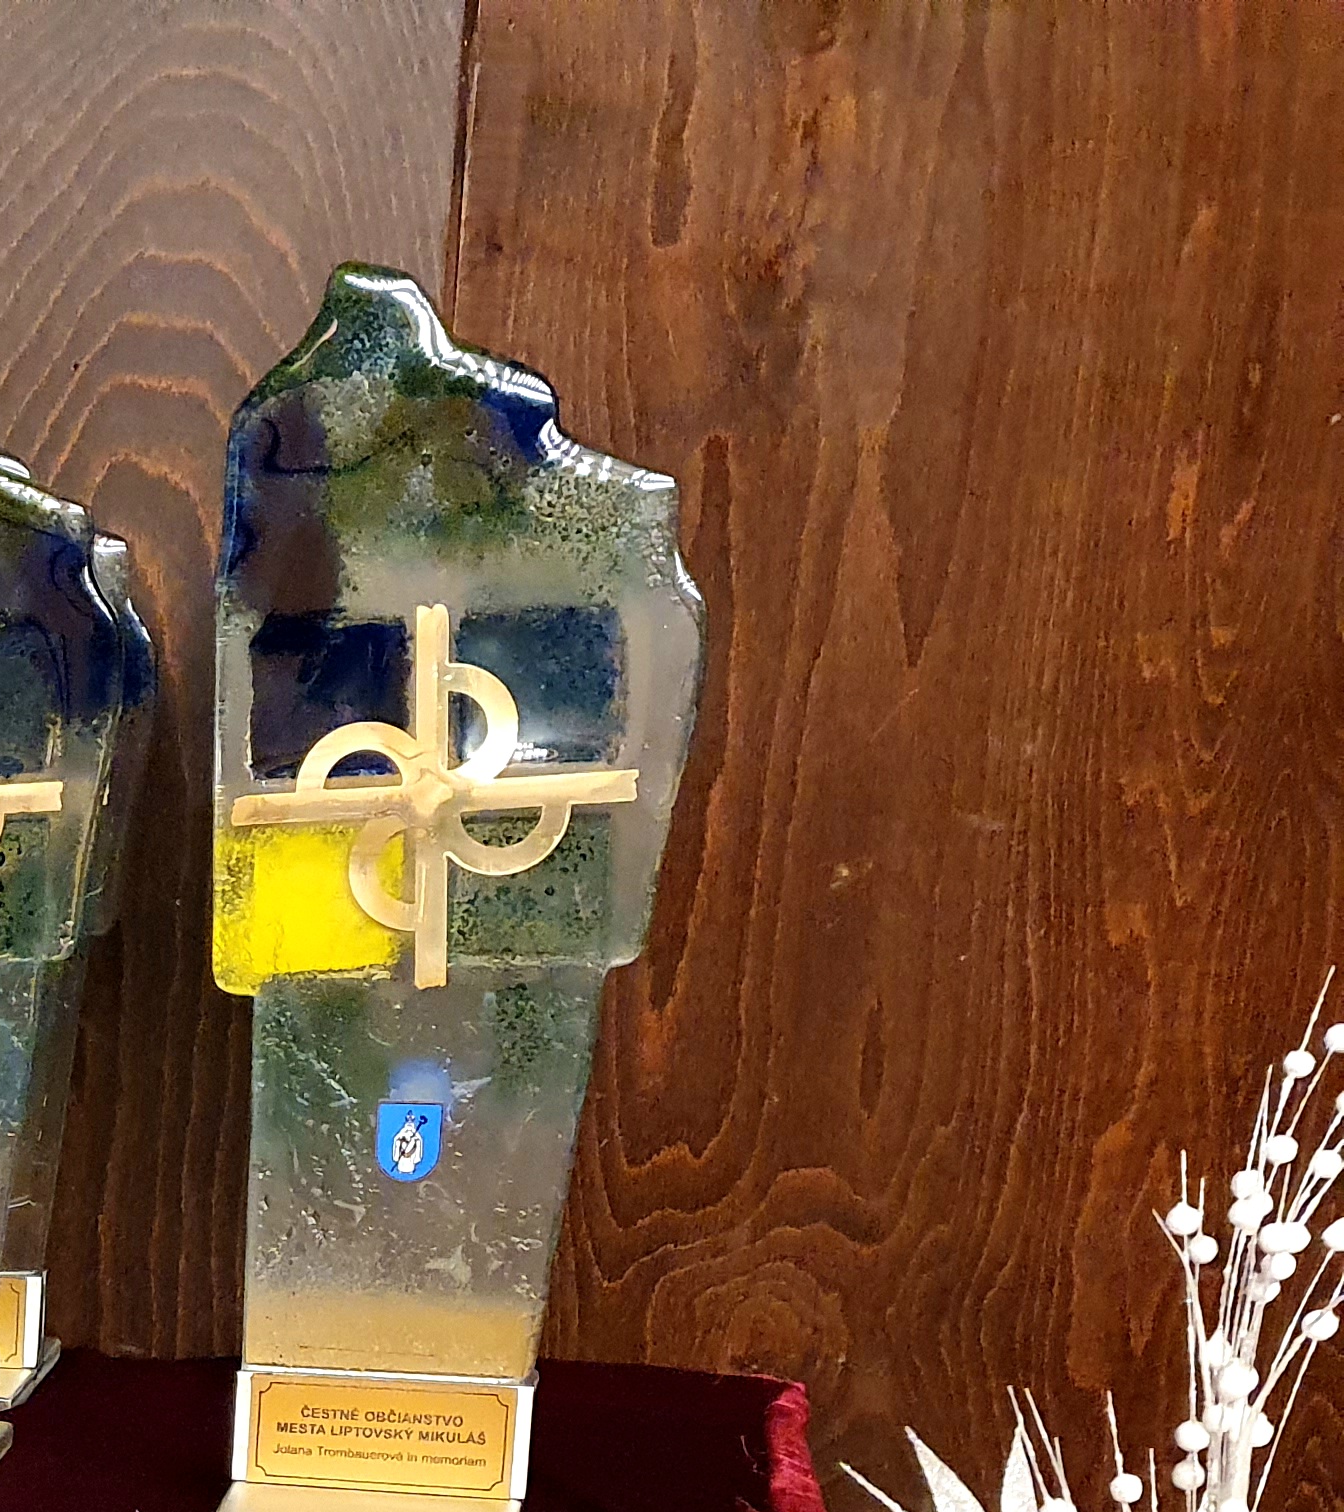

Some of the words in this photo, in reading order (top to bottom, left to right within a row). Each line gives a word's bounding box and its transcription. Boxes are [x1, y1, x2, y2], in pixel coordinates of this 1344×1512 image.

[300, 1404, 360, 1421] ČESTNÉ
[364, 1408, 464, 1428] OBČIANSTVO
[276, 1421, 326, 1435] MESTA
[330, 1424, 414, 1440] LIPTOVSKÝ
[272, 1443, 313, 1456] Jolana
[406, 1451, 418, 1463] in
[421, 1455, 487, 1467] memoriam
